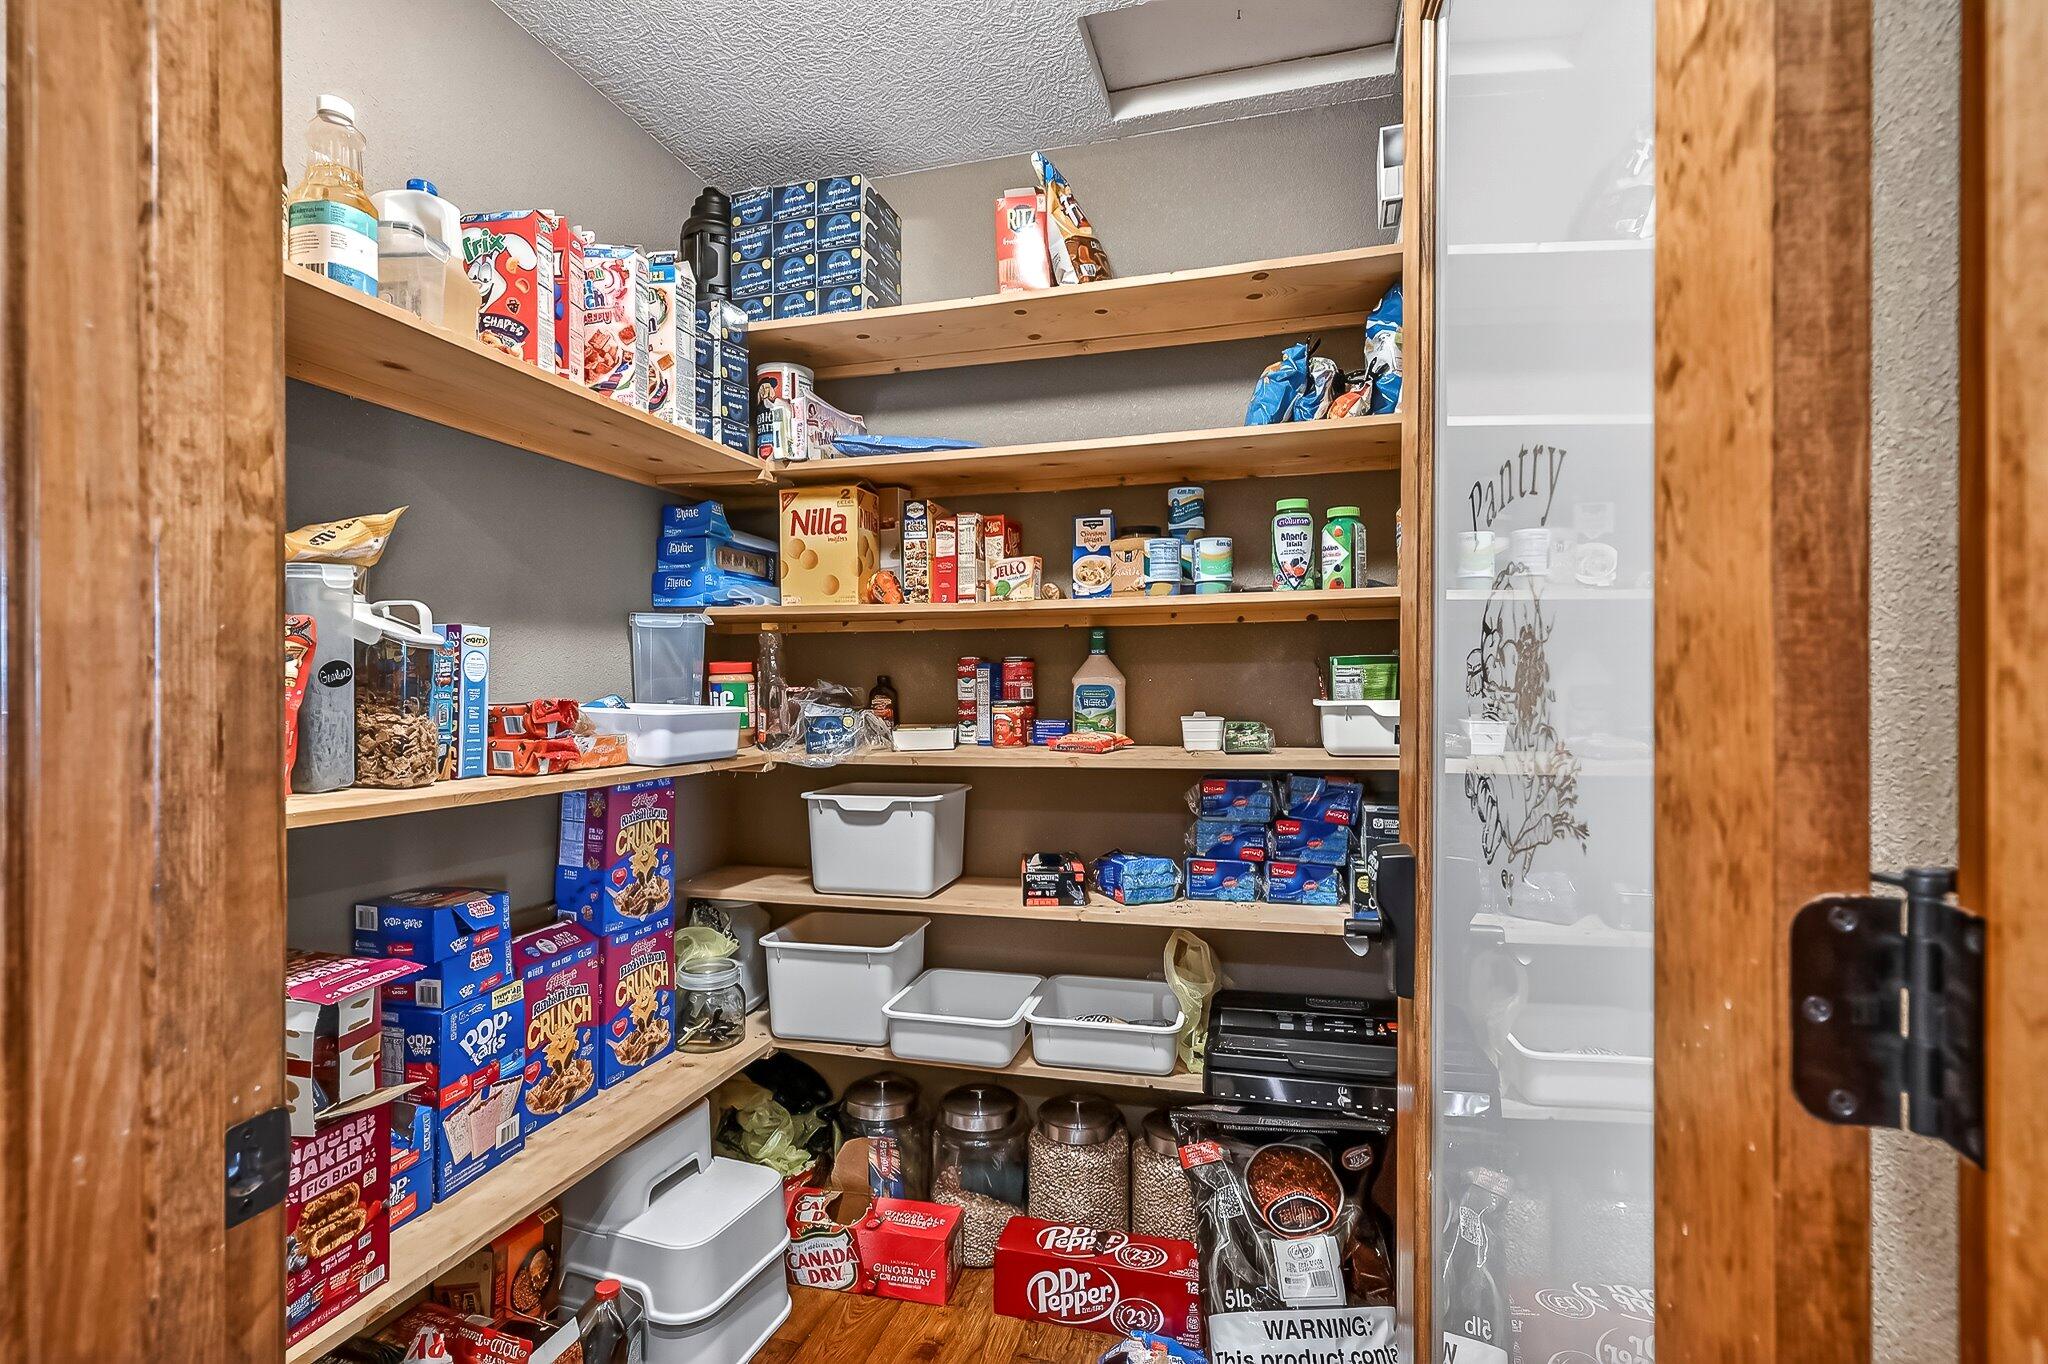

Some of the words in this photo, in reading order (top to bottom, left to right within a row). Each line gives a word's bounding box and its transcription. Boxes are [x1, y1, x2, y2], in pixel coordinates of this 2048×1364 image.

[1008, 208, 1036, 230] RITZ
[840, 489, 851, 500] 2
[790, 508, 848, 537] Nilla
[615, 820, 670, 856] CRUNCH
[615, 962, 669, 1007] CRUNCH
[527, 996, 592, 1050] CRUNCH
[289, 1128, 376, 1187] BAKERY
[306, 1176, 328, 1199] FIG
[332, 1160, 358, 1184] BAR
[787, 1246, 860, 1271] CANADA
[1131, 1249, 1151, 1261] 23
[808, 1265, 844, 1285] DRY
[917, 1268, 938, 1280] ALE
[1059, 1267, 1091, 1292] Dr
[1037, 1271, 1112, 1318] Pepper
[1225, 1289, 1251, 1309] 5lb
[1126, 1308, 1147, 1327] 23
[1263, 1315, 1374, 1341] WARNING:
